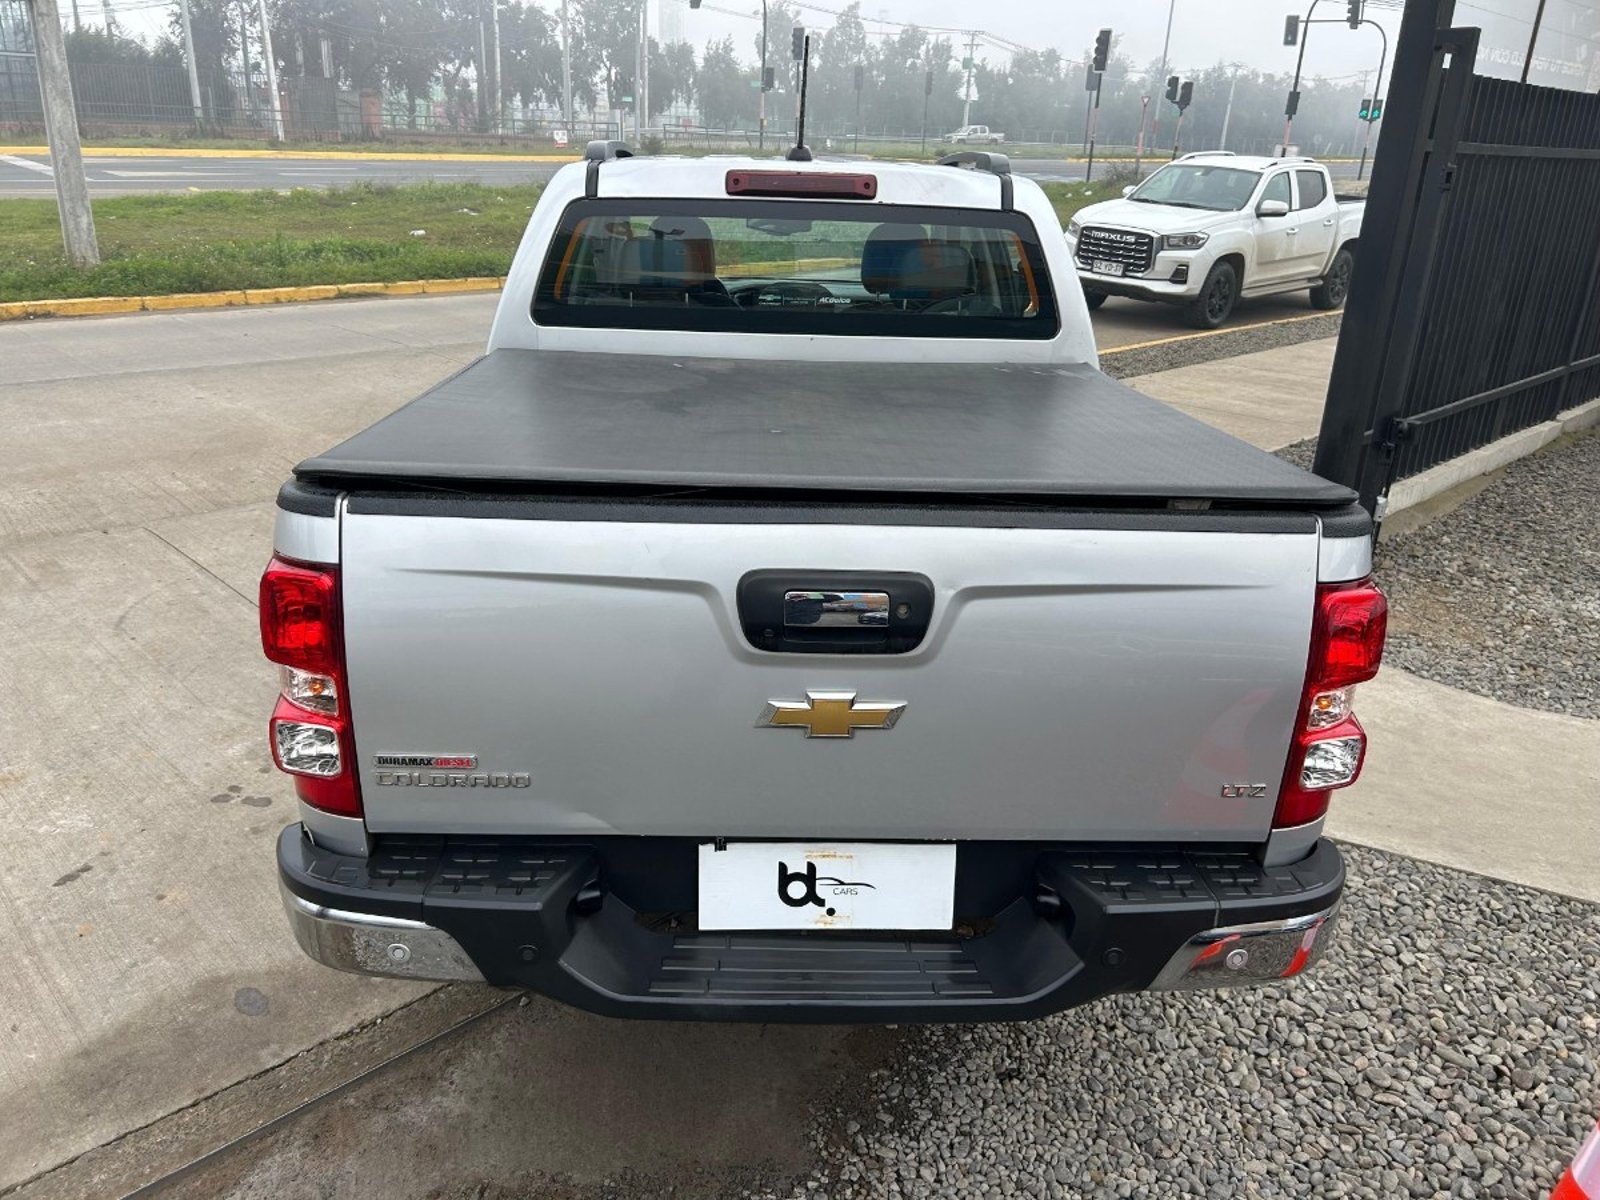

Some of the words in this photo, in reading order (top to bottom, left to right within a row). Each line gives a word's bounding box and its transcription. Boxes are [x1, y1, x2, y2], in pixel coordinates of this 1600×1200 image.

[1091, 230, 1136, 242] MAXUS
[376, 755, 434, 766] DURAMAX
[375, 771, 532, 788] COLORADO
[1221, 783, 1267, 798] LTZ
[833, 888, 858, 896] CARS
